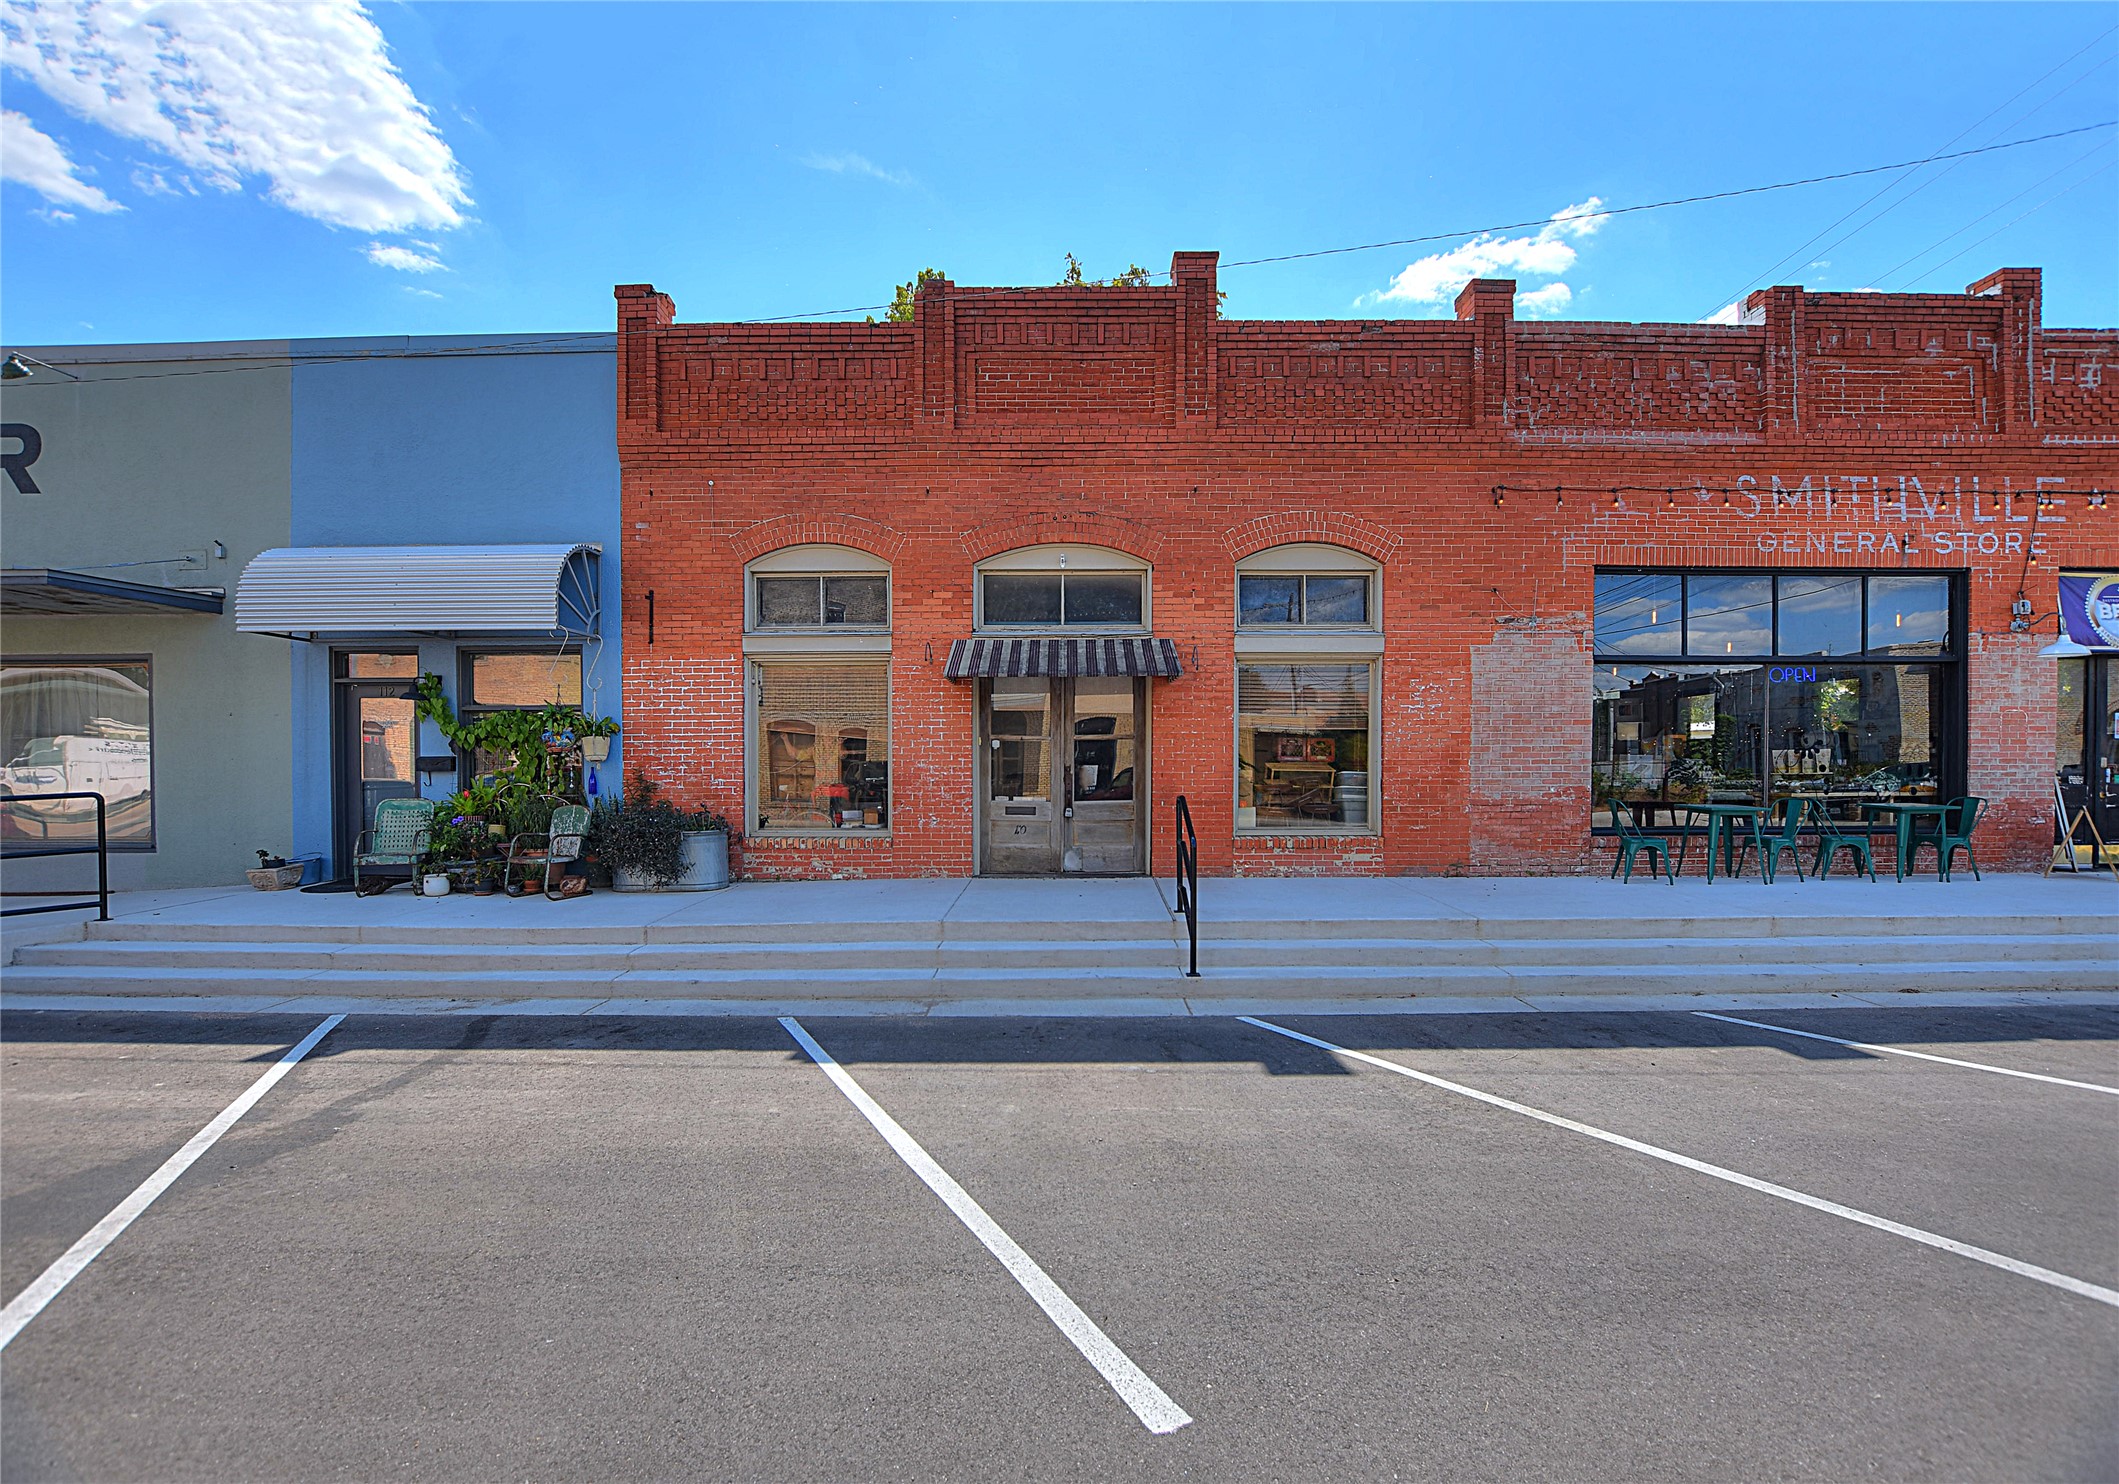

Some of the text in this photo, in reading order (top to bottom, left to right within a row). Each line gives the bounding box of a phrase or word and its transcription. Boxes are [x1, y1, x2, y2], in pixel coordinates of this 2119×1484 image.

[0, 423, 41, 494] R
[1736, 474, 2066, 522] SMITHVILLE
[1757, 531, 2047, 555] GENERAL STORE
[1769, 666, 1816, 683] OPEN
[379, 686, 396, 697] 112
